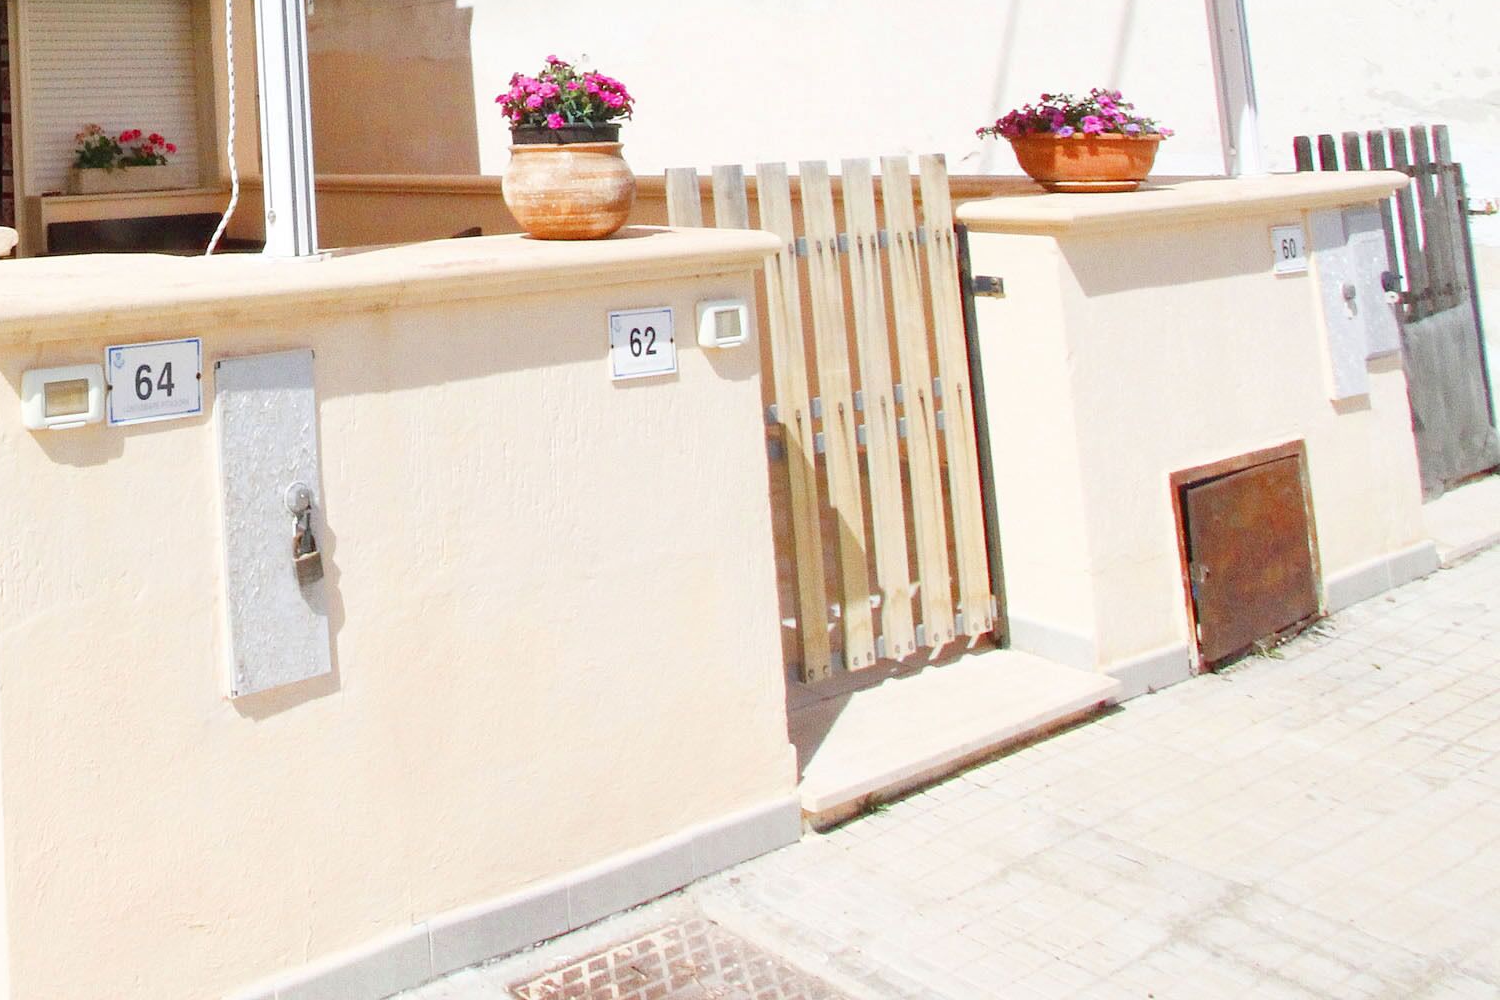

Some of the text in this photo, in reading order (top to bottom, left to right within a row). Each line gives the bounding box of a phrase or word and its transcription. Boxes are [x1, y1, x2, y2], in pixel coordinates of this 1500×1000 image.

[1281, 238, 1297, 259] 60
[630, 326, 657, 357] 62
[134, 361, 175, 401] 64
